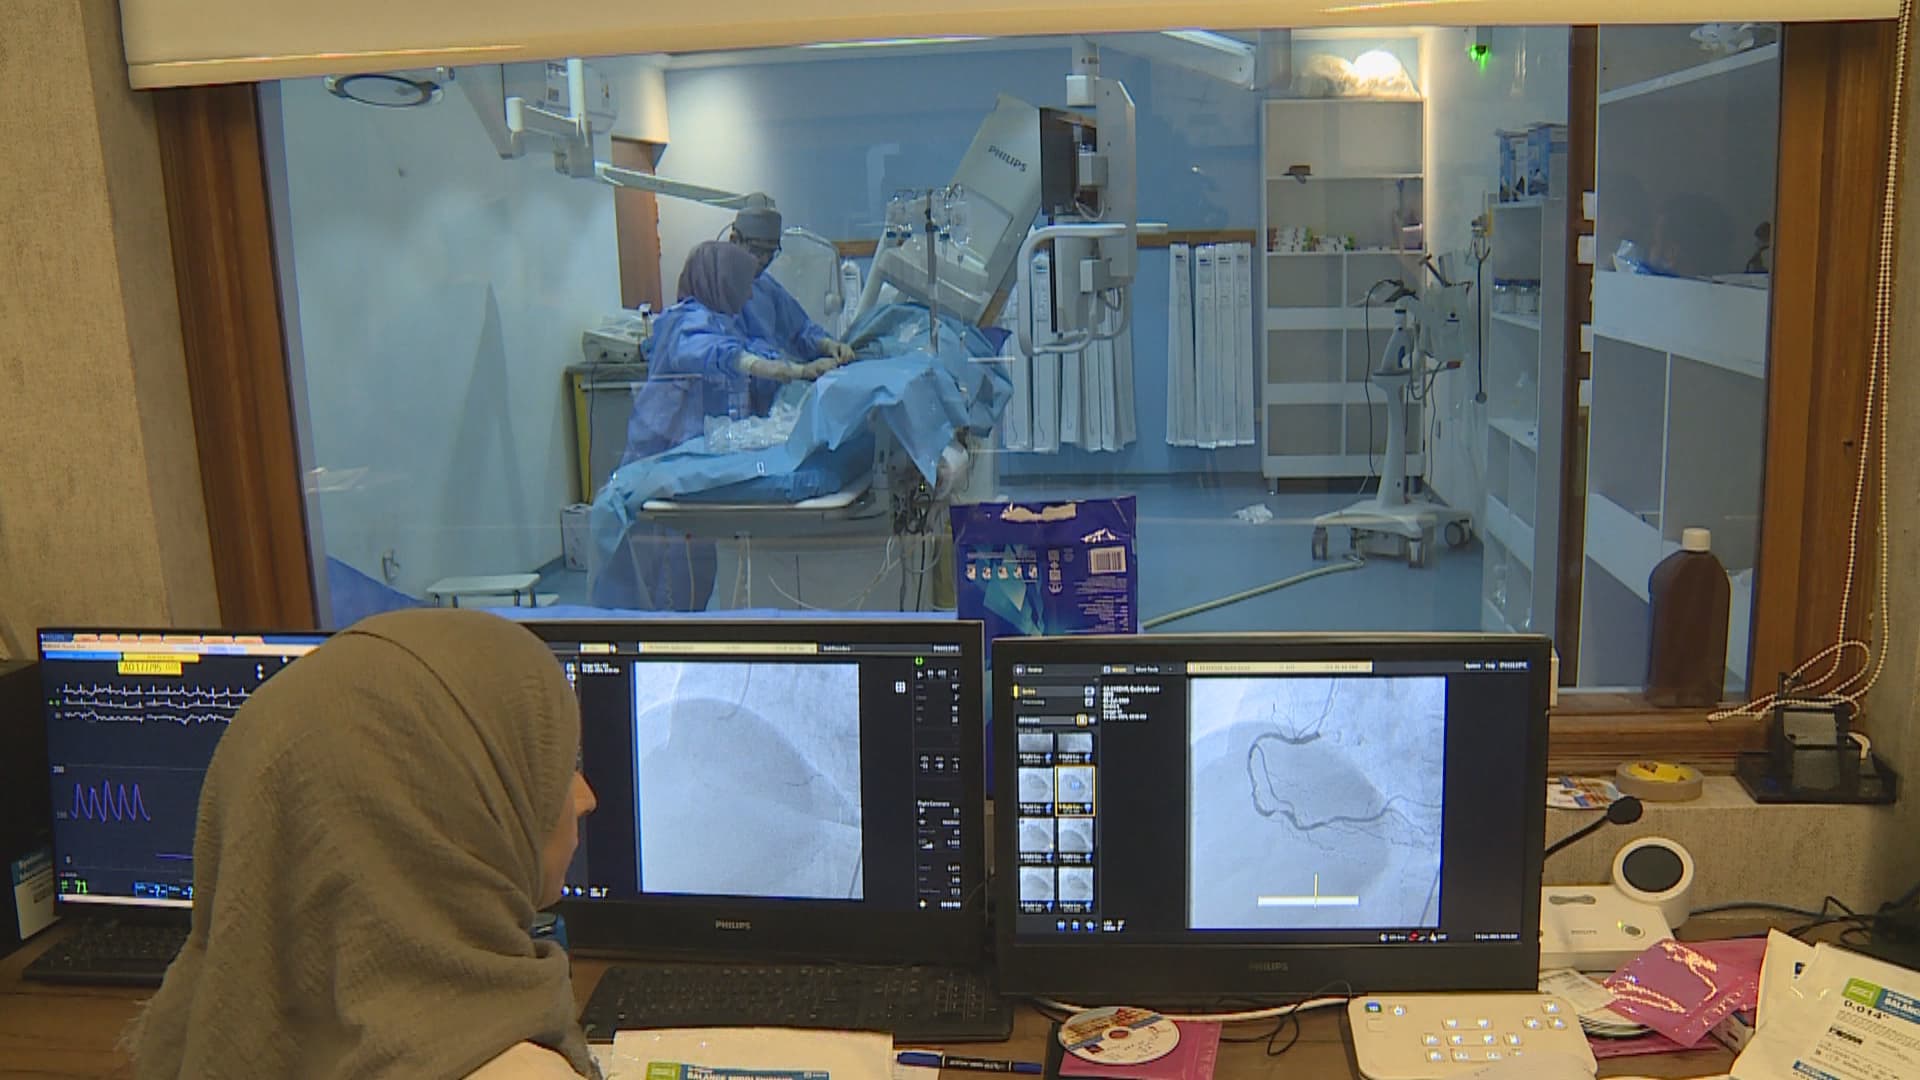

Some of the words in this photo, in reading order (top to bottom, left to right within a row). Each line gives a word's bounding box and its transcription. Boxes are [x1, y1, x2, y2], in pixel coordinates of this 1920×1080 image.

[988, 145, 1027, 172] PHILIPS
[75, 880, 88, 895] 71
[715, 919, 752, 930] PHILIPS
